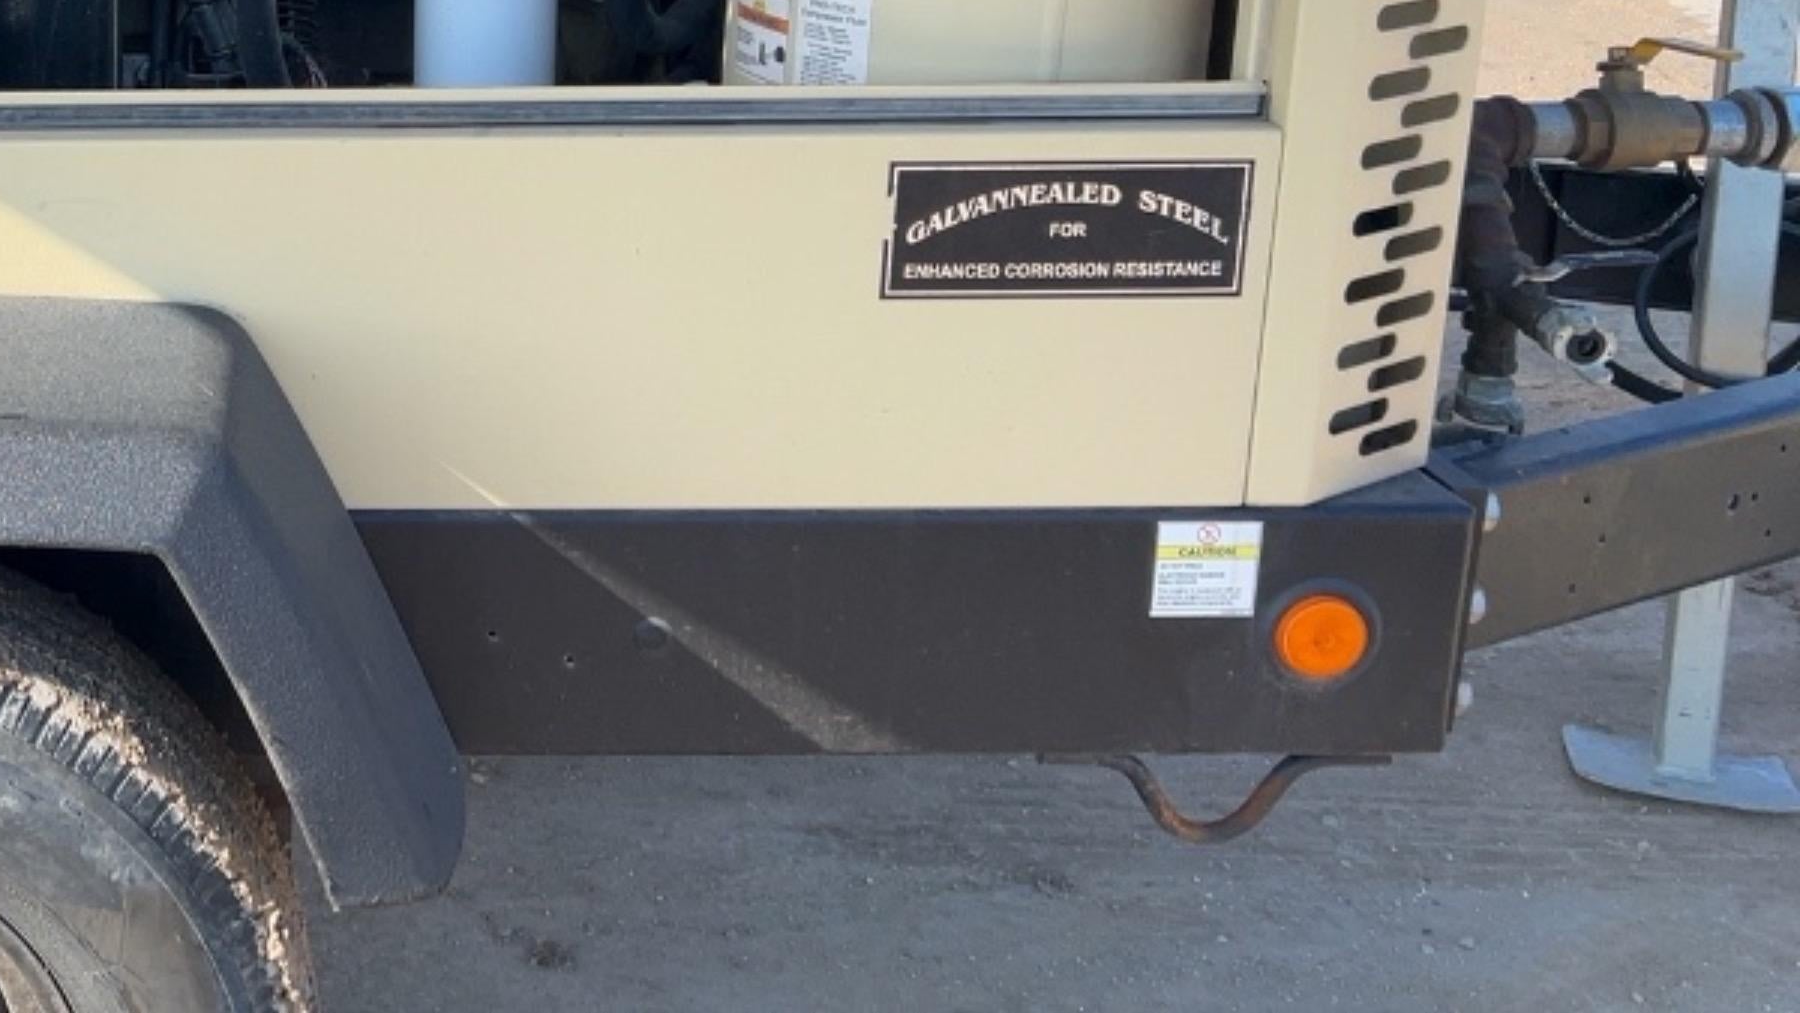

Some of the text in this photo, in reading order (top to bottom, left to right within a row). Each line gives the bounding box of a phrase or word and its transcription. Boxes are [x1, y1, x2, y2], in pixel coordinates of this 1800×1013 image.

[904, 181, 1229, 245] GALVANNEALED STEEL
[1048, 222, 1087, 238] FOR
[902, 259, 1223, 279] ENHANCED CORROSION RESISTANCE
[1178, 545, 1236, 557] CAUTION
